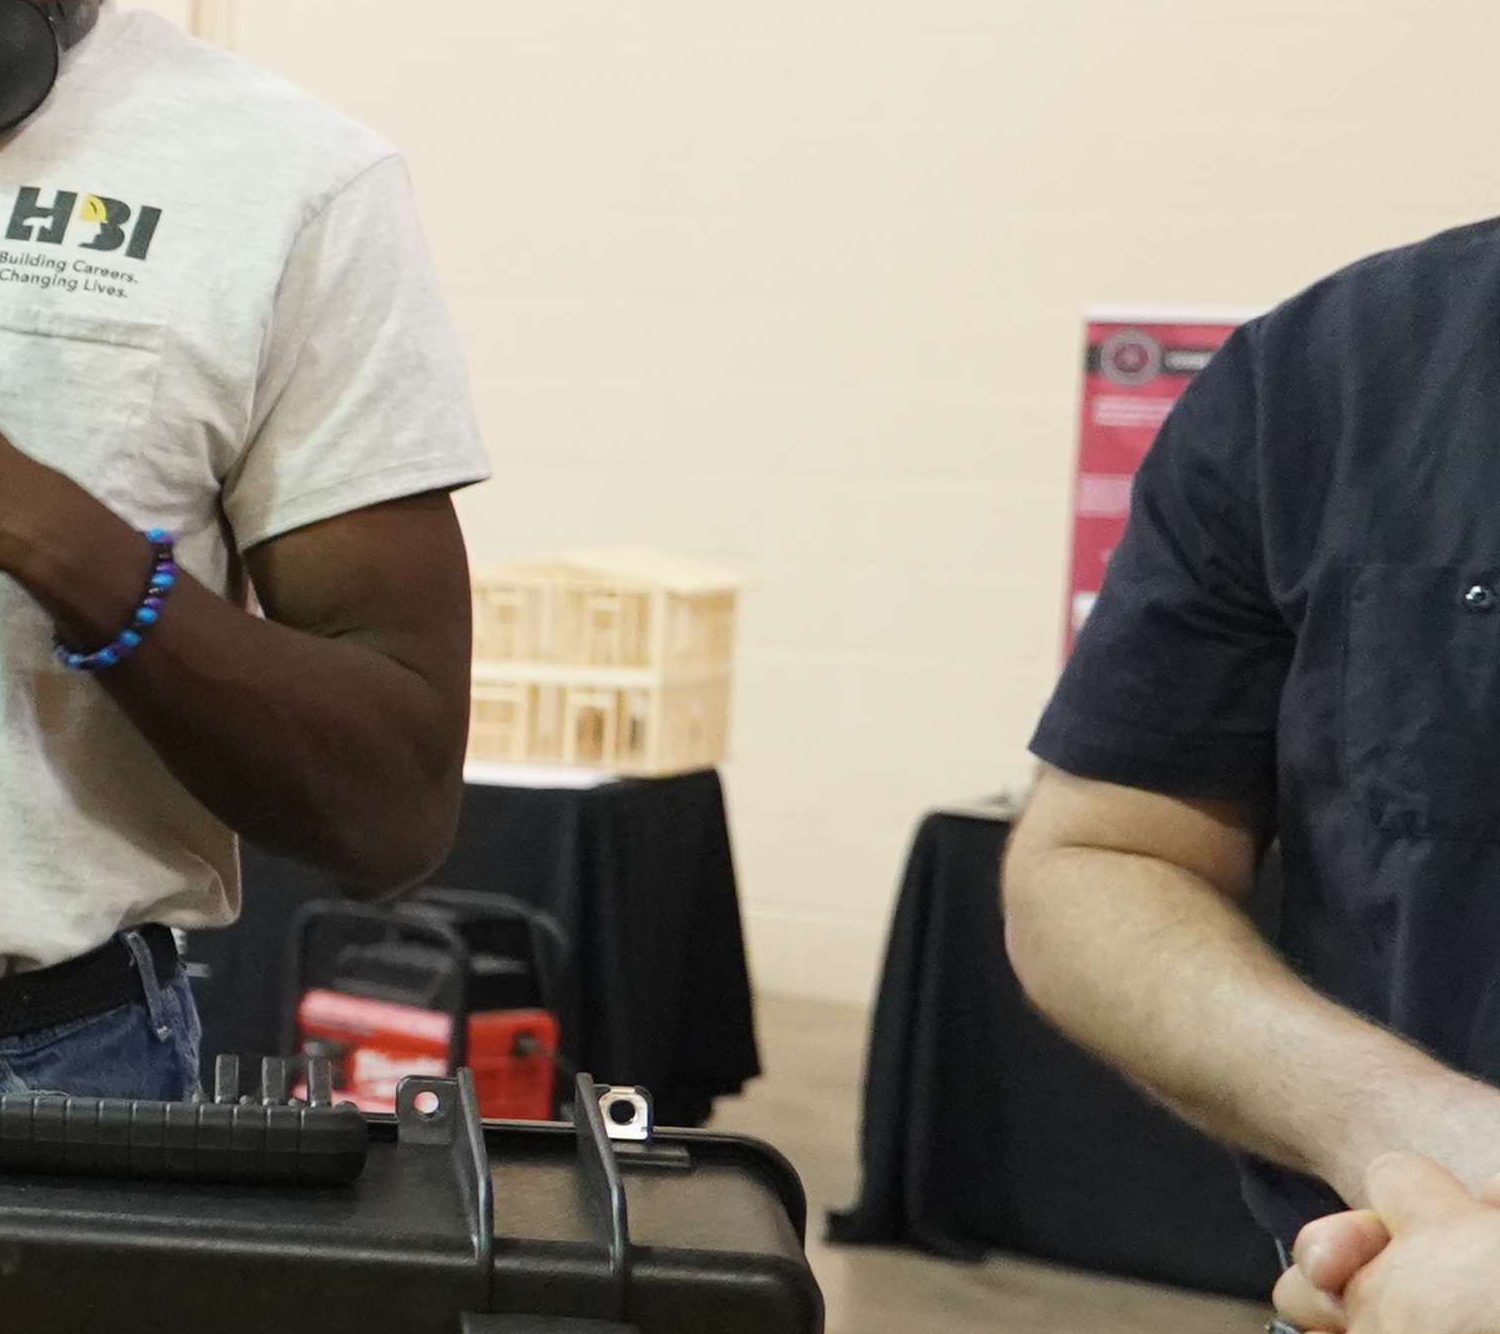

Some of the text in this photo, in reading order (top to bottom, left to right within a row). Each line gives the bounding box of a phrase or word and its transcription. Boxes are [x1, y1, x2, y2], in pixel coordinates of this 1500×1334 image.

[4, 185, 163, 261] HBI
[72, 259, 139, 284] Careers.
[83, 278, 129, 299] Lives.
